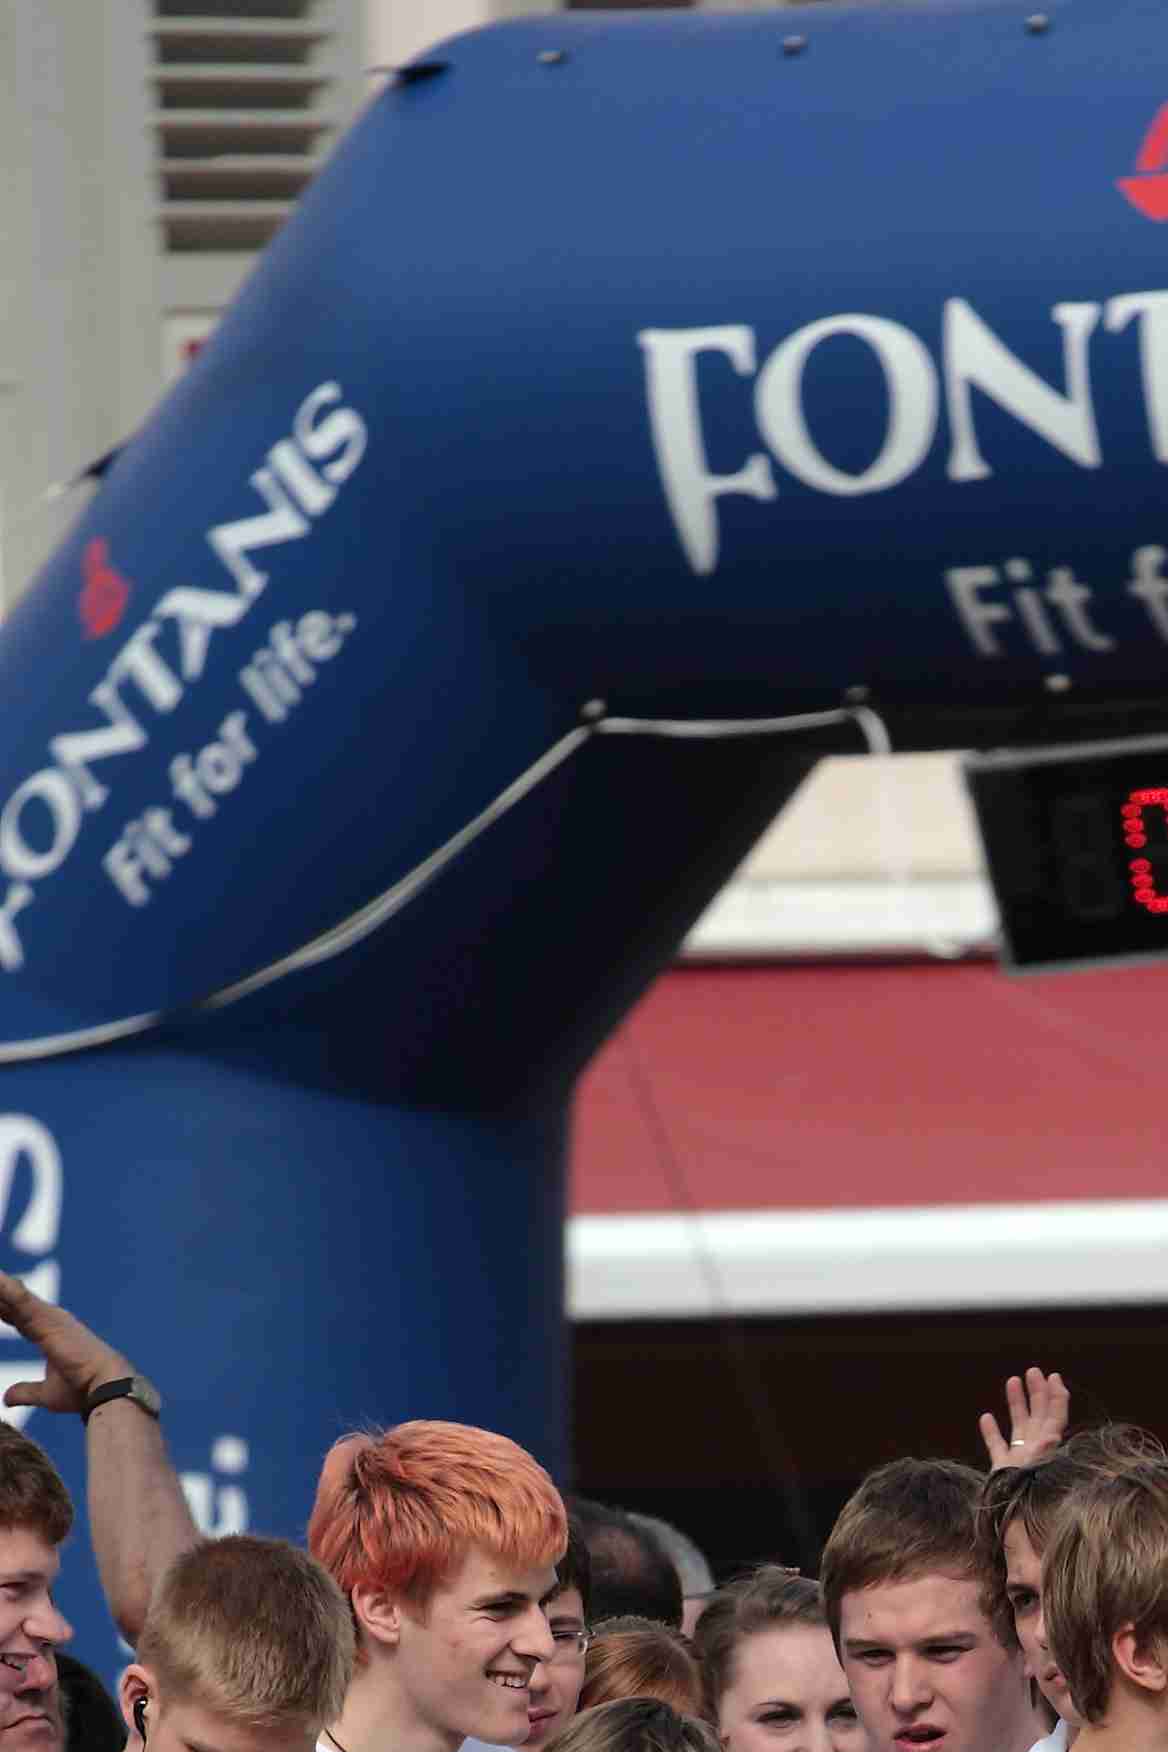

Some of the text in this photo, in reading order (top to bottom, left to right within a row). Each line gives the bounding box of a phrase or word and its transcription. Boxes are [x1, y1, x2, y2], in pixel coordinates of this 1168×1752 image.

[944, 557, 1116, 656] Fit
[103, 609, 357, 906] Fit for life.
